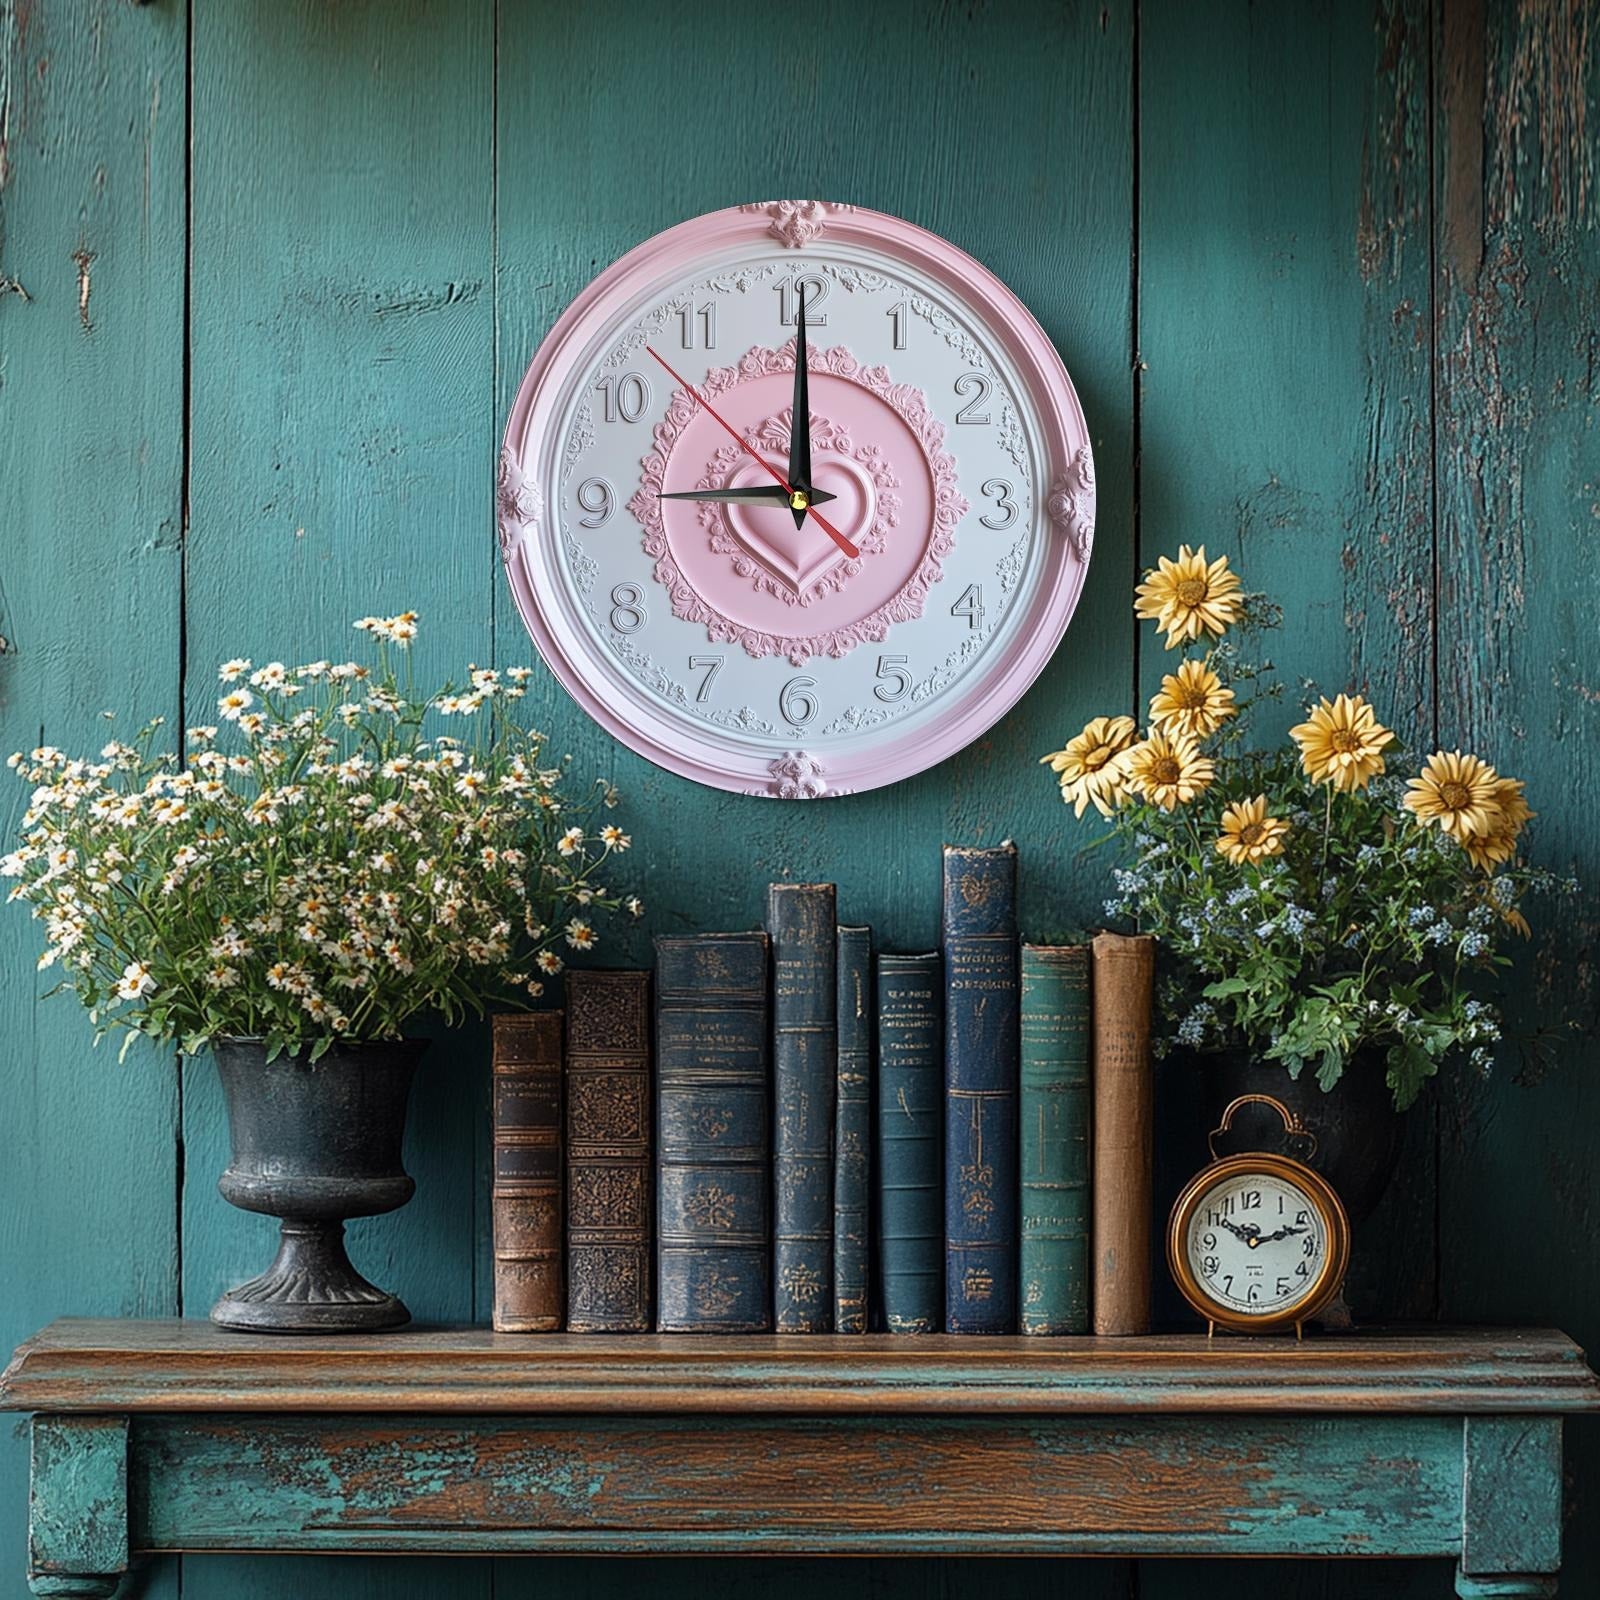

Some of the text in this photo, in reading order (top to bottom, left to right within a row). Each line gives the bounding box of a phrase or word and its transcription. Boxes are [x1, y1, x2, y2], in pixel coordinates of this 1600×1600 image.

[773, 273, 830, 326] 12
[674, 300, 717, 349] 11
[886, 303, 909, 350] 1
[596, 371, 652, 424] 10
[954, 373, 992, 425] 2
[577, 477, 617, 529] 9
[980, 477, 1018, 530] 3
[610, 580, 648, 634] 8
[951, 583, 985, 629] 4
[689, 655, 724, 702] 7
[780, 675, 819, 726] 6
[875, 655, 912, 701] 5
[1278, 1195, 1283, 1214] 1
[1203, 1232, 1217, 1251] 9
[1223, 1275, 1233, 1296] 7
[1295, 1260, 1309, 1281] 4
